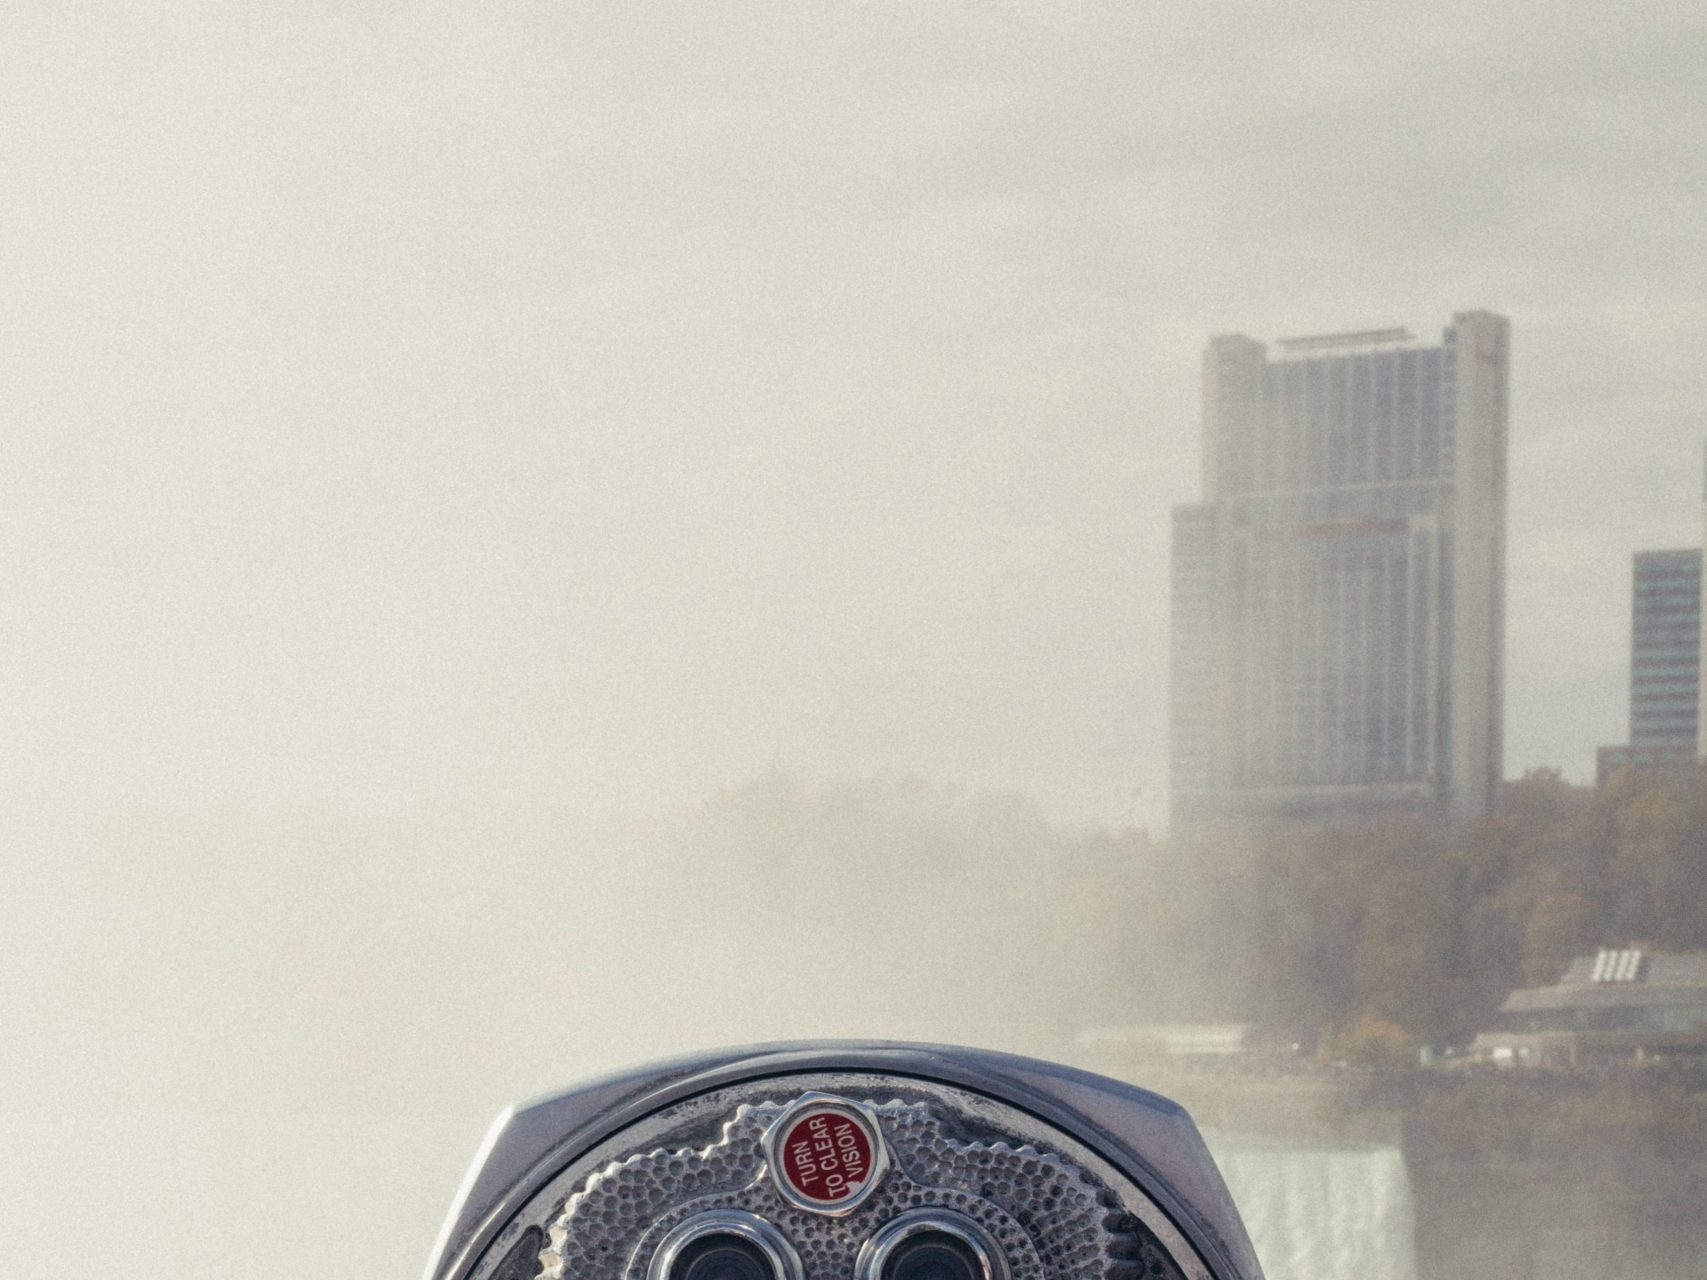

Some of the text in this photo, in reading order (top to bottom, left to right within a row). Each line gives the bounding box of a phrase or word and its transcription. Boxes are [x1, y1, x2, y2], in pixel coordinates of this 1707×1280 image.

[792, 1140, 819, 1187] TURN
[809, 1116, 847, 1197] TO CLEAR
[834, 1122, 864, 1178] VISION
